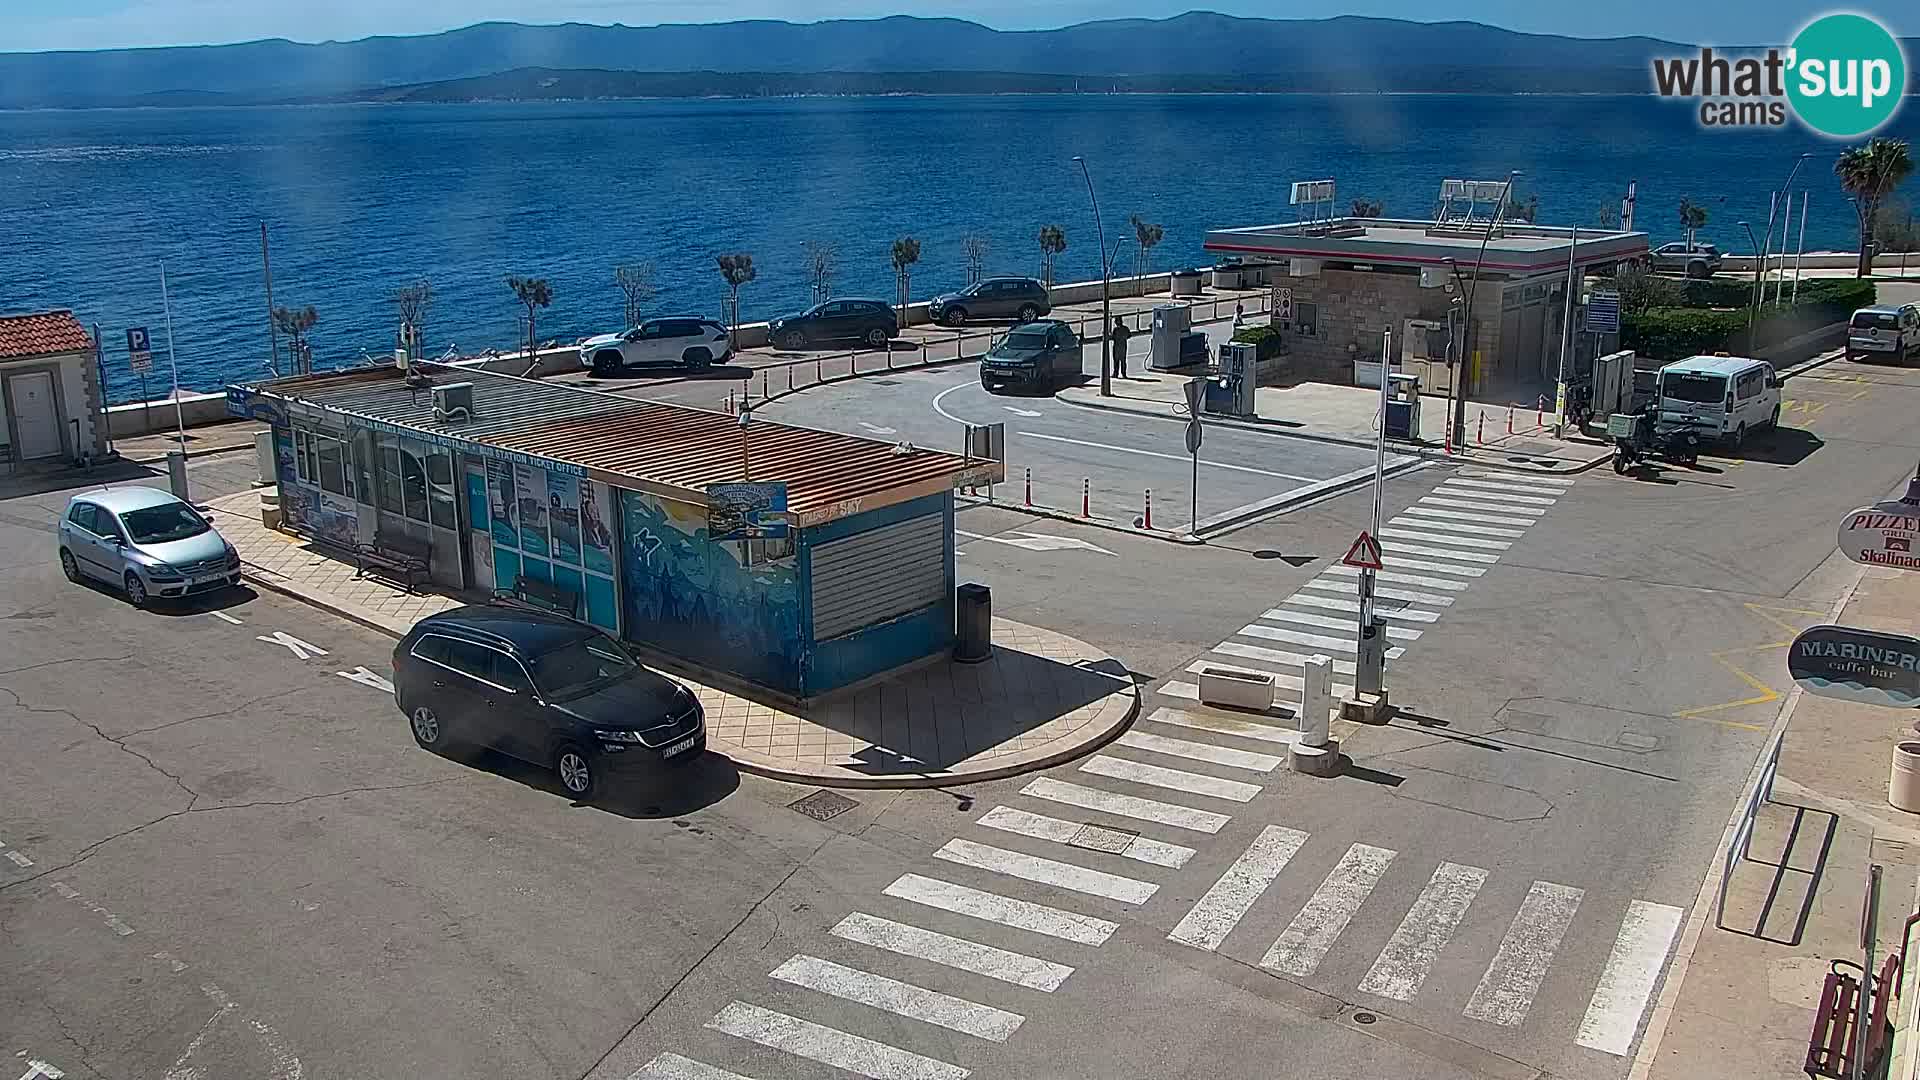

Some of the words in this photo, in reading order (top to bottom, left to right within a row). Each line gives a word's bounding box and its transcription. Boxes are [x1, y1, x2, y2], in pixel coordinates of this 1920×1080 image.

[132, 330, 144, 349] P
[398, 427, 437, 443] AUTOBUSNA
[437, 435, 469, 451] POSTAJA
[479, 445, 494, 456] BUS
[495, 449, 527, 464] STATION
[529, 456, 555, 471] TICKET
[557, 462, 583, 476] OFFICE
[1848, 514, 1920, 533] PIZZE
[1881, 529, 1916, 540] GRILL
[1829, 661, 1865, 673] caffe
[1871, 664, 1896, 679] bar
